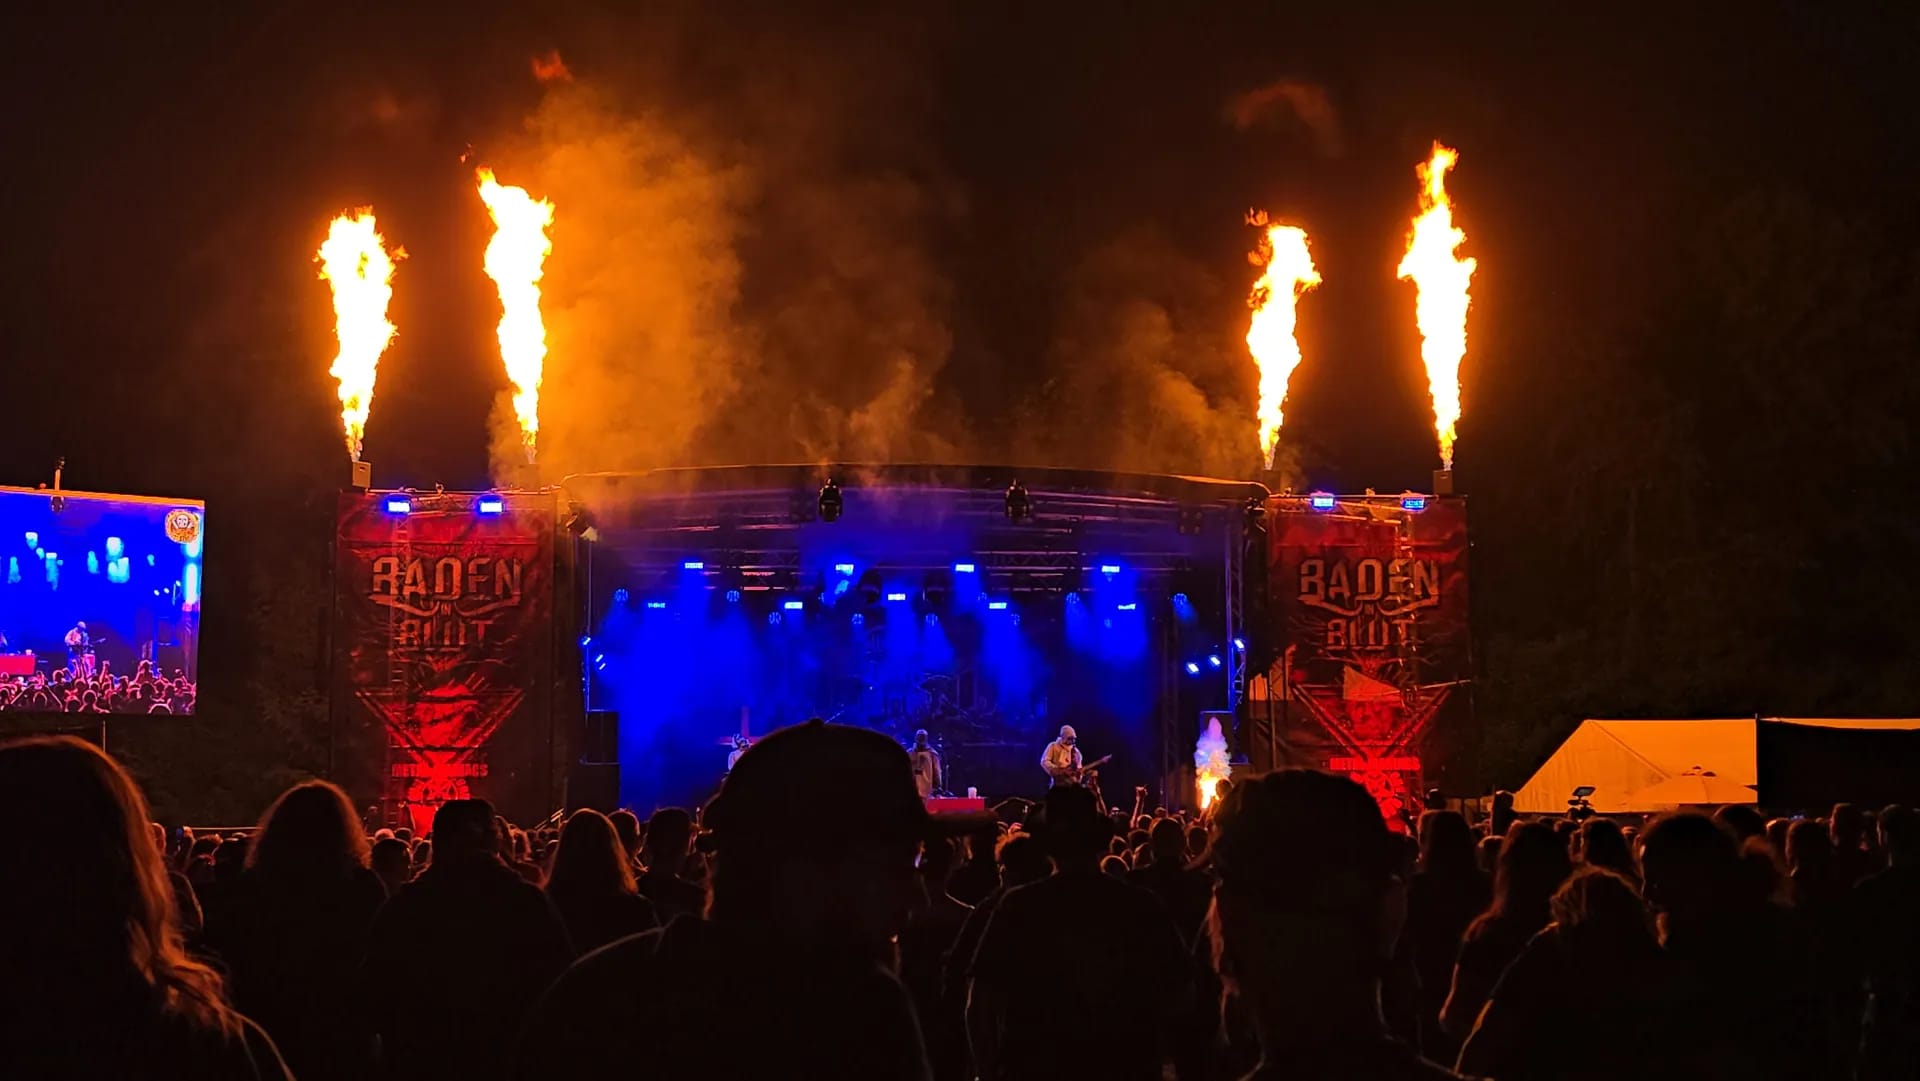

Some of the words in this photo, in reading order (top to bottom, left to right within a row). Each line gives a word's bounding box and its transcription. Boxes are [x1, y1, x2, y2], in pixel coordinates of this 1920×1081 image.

[370, 556, 523, 602] BADEN
[1298, 557, 1438, 602] BADEN
[397, 618, 494, 651] BLUT
[1326, 617, 1416, 651] BLUT
